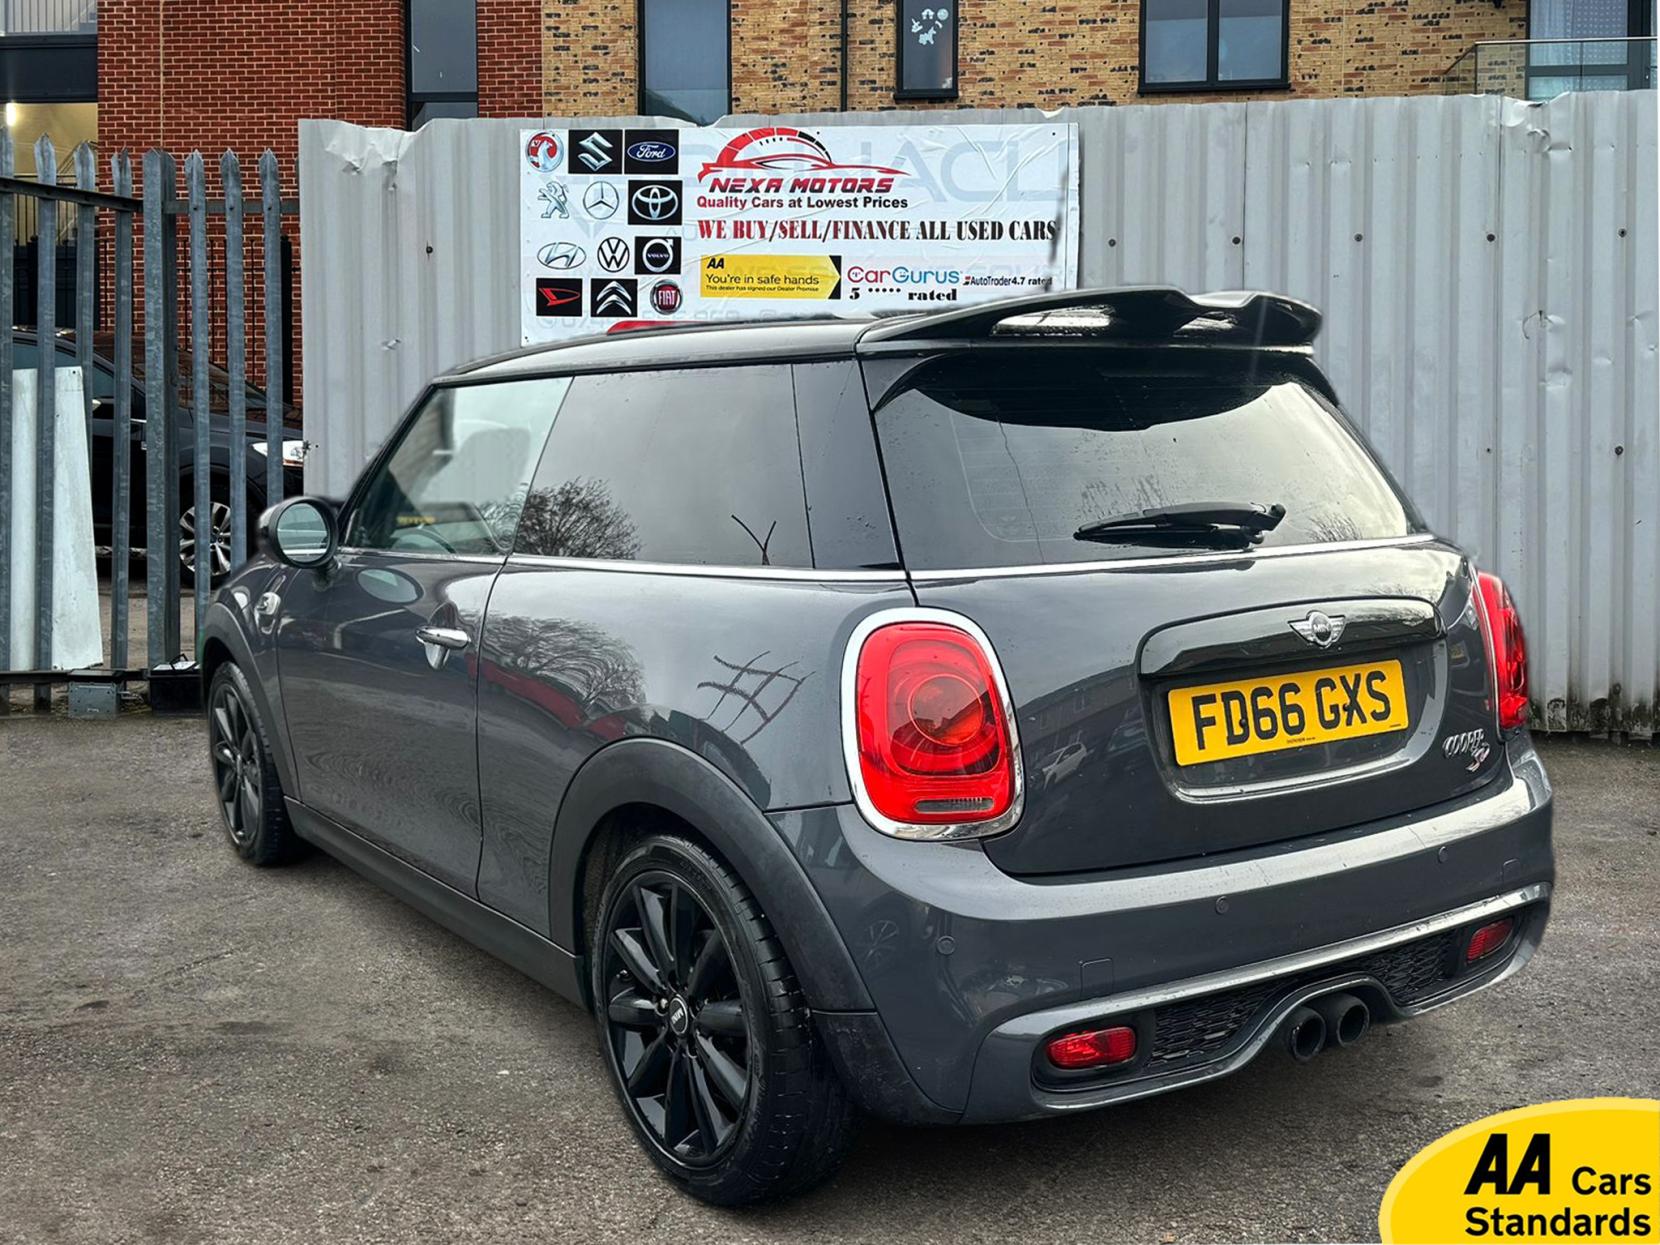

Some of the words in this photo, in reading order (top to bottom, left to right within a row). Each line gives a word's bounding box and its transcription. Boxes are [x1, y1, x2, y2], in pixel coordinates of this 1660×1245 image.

[636, 143, 666, 159] Ford
[708, 177, 784, 194] NEXA
[789, 177, 895, 194] MOTORS
[696, 196, 748, 210] Quality
[751, 196, 784, 208] Cars
[788, 197, 803, 208] at
[807, 196, 859, 208] Lowest
[863, 196, 909, 208] Prices
[697, 220, 727, 240] WE
[916, 220, 950, 241] ALL
[956, 220, 1004, 241] USED
[1008, 220, 1057, 241] CARS
[706, 257, 725, 270] AA
[705, 273, 741, 284] You're
[744, 274, 755, 284] in
[757, 273, 782, 285] safe
[783, 274, 820, 285] hands
[847, 265, 960, 284] CarGurus
[657, 290, 676, 306] FIAT
[849, 287, 861, 301] 5
[907, 288, 958, 301] rated
[1191, 681, 1306, 751] FD66
[1315, 670, 1392, 730] GXS
